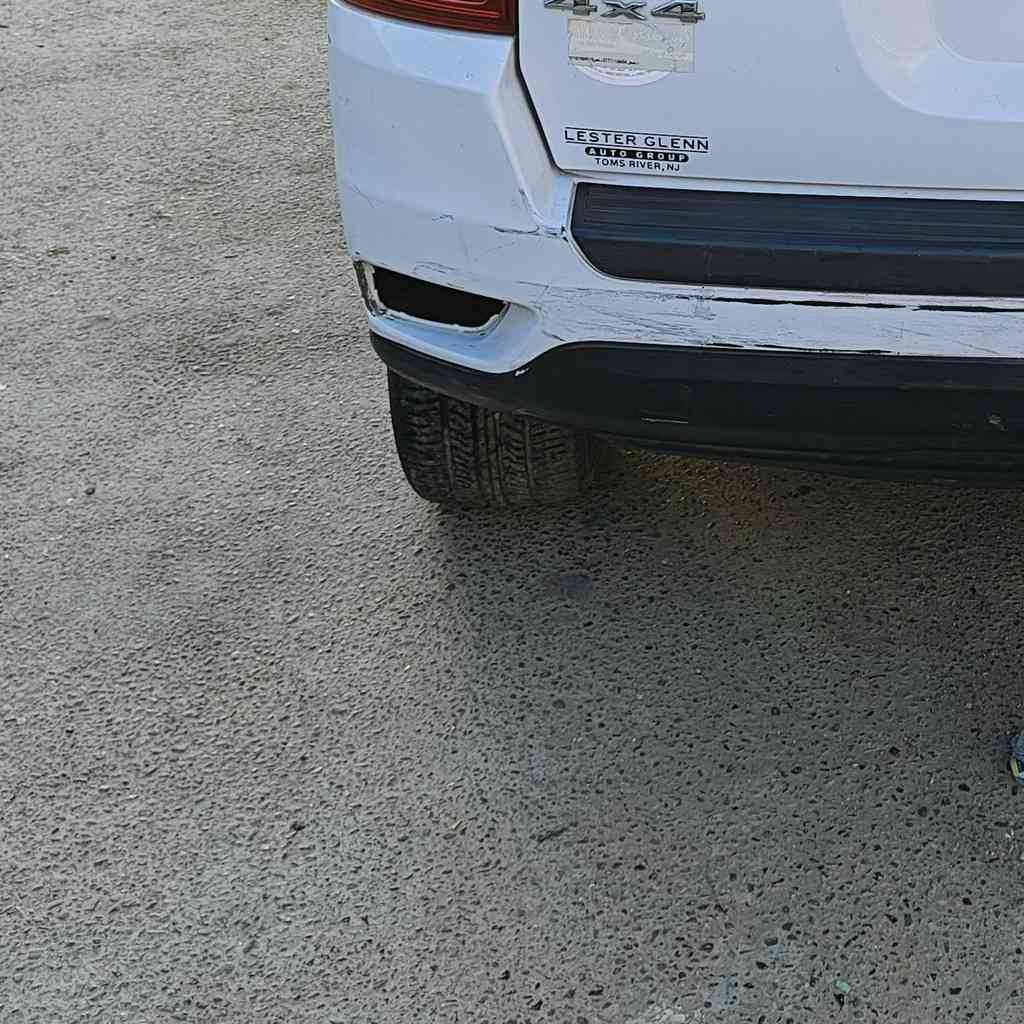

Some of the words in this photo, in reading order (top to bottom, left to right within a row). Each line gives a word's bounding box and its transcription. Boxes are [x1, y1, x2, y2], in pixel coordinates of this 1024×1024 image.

[564, 129, 637, 146] LESTER
[644, 136, 709, 151] GLENN
[588, 147, 627, 159] AUTO
[635, 150, 686, 162] GROUP
[595, 157, 626, 169] TOMS
[628, 160, 665, 172] RIVER,
[666, 163, 680, 172] NJ
